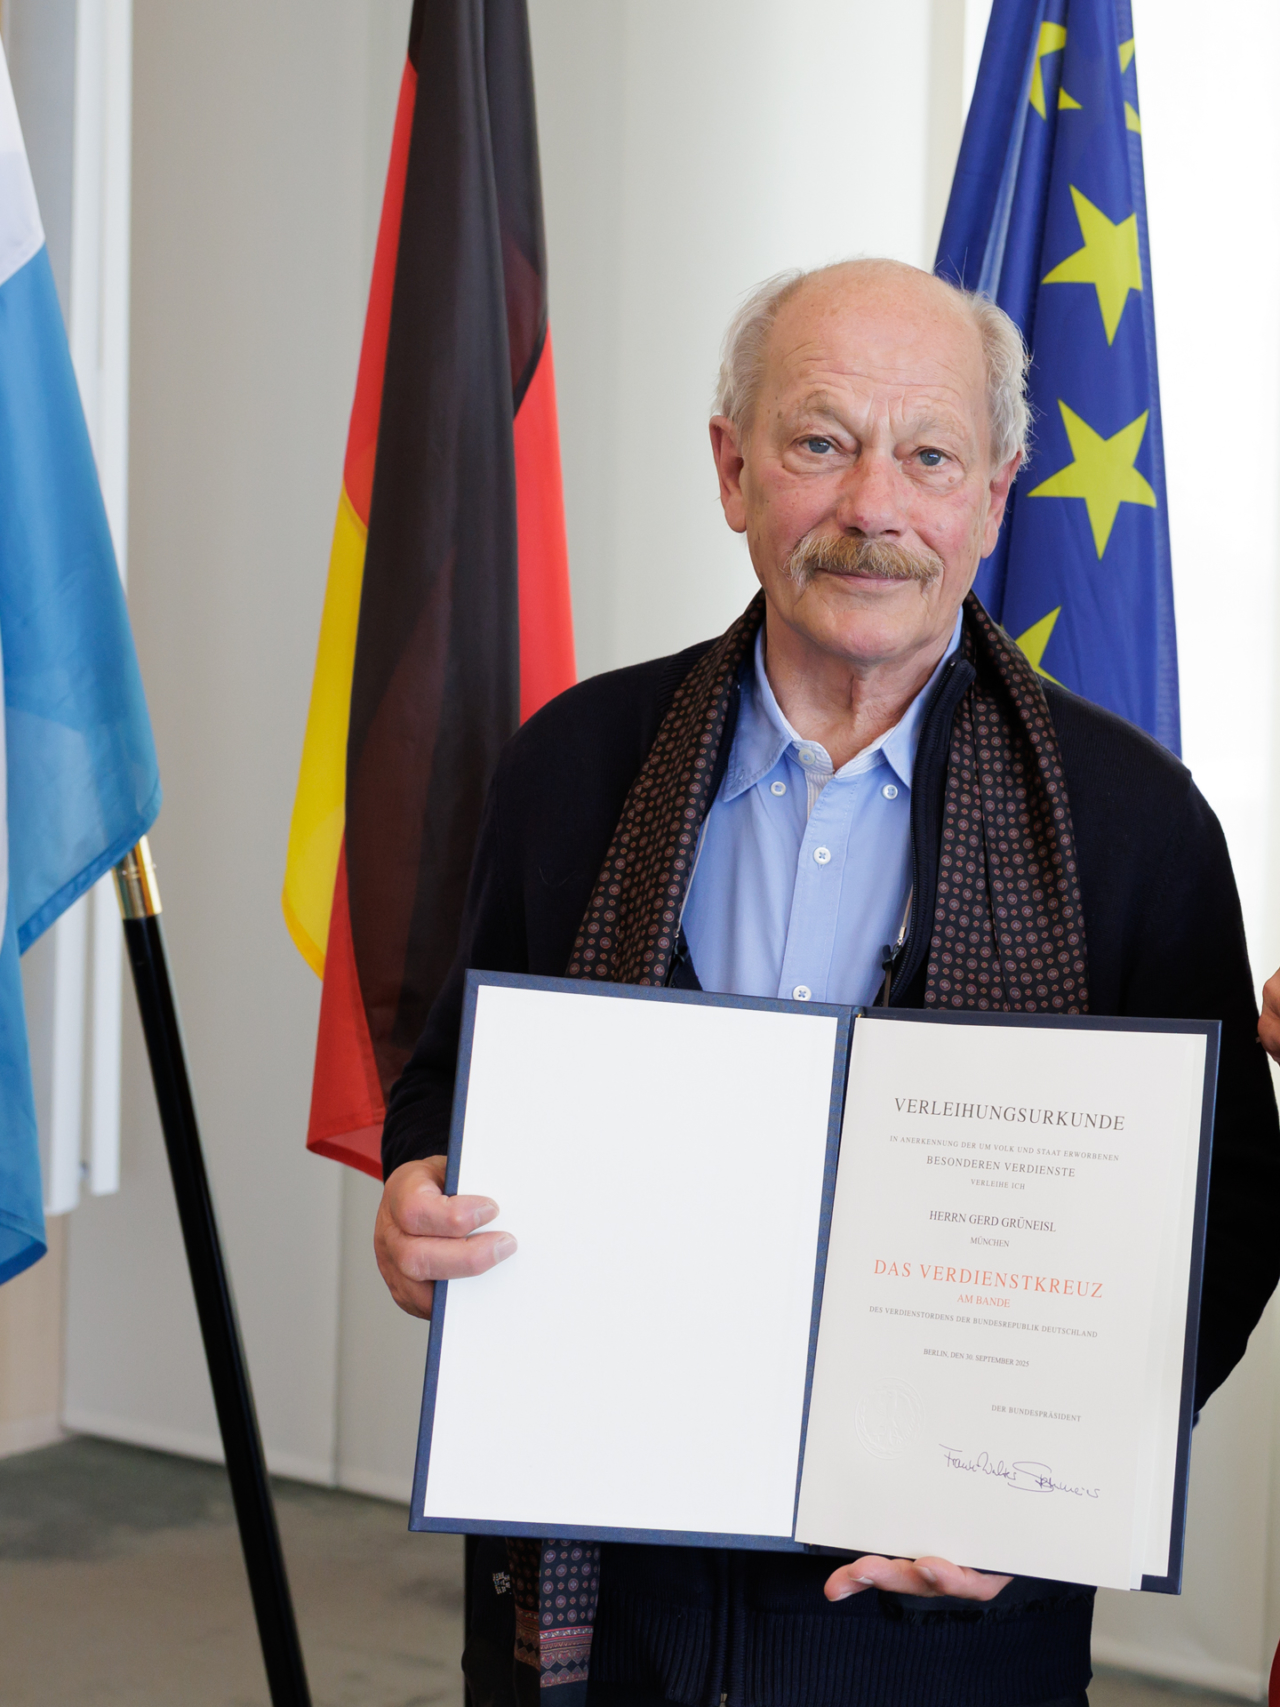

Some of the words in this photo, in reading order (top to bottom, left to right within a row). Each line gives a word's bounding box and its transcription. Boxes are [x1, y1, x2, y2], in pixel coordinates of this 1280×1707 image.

[894, 1097, 1126, 1131] VERLEIHUNGSURKUNDE
[889, 1135, 899, 1143] IN
[900, 1136, 959, 1148] ANERKENNUNG
[960, 1141, 977, 1149] DER
[978, 1142, 992, 1151] UM
[993, 1144, 1015, 1153] VOLK
[1017, 1146, 1035, 1154] UND
[1036, 1147, 1062, 1157] STAAT
[1063, 1150, 1120, 1162] ERWORBENEN
[926, 1155, 1001, 1171] BESONDEREN
[1004, 1162, 1076, 1178] VERDIENSTE
[970, 1178, 1009, 1189] VERLEIHE
[1011, 1182, 1026, 1191] ICH
[929, 1210, 967, 1223] HERRN
[968, 1214, 1000, 1227] GERD
[1000, 1216, 1057, 1233] GRÜNEISL
[970, 1235, 1010, 1248] MÜNCHEN
[873, 1259, 911, 1278] DAS
[920, 1264, 1104, 1299] VERDIENSTKREUZ
[956, 1294, 974, 1304] AM
[975, 1295, 1011, 1309] BANDE
[868, 1305, 883, 1314] DES
[884, 1307, 955, 1322] VERDIENSTORDENS
[955, 1315, 971, 1324] DER
[972, 1317, 1040, 1332] BUNDESREPUBLIK
[1040, 1325, 1098, 1338] DEUTSCHLAND
[950, 1351, 965, 1359] DEN
[974, 1354, 1015, 1366] SEPTEMBER
[1015, 1359, 1030, 1368] 2025
[991, 1404, 1007, 1413] DER
[1008, 1406, 1082, 1423] BUNDESPRÄSIDENT
